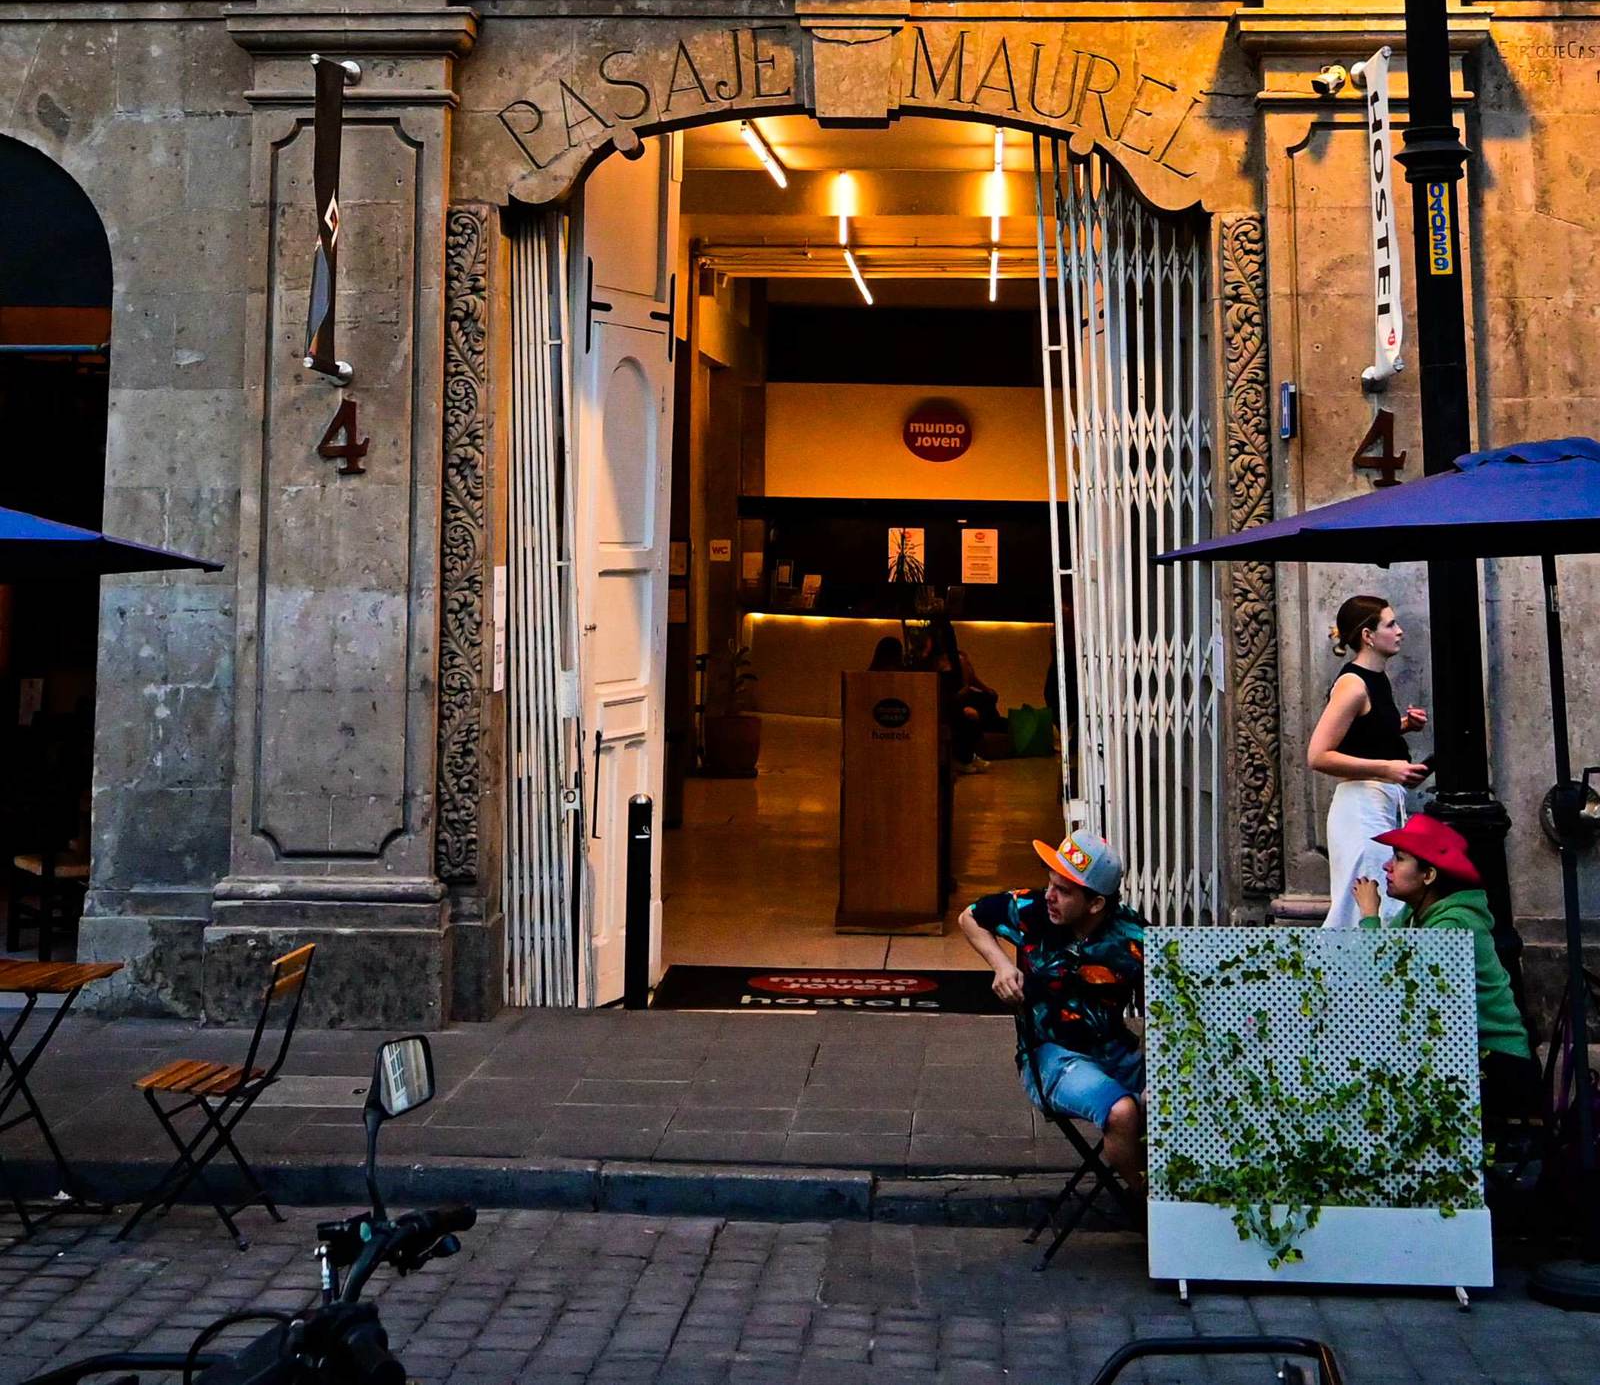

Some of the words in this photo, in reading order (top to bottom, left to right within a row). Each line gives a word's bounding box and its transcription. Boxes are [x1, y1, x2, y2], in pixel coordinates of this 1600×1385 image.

[496, 25, 792, 169] PASAJE
[905, 26, 1203, 180] MAUREL
[318, 398, 370, 475] 4
[1352, 408, 1406, 487] 4
[711, 546, 729, 555] WC
[740, 994, 940, 1008] hostels
